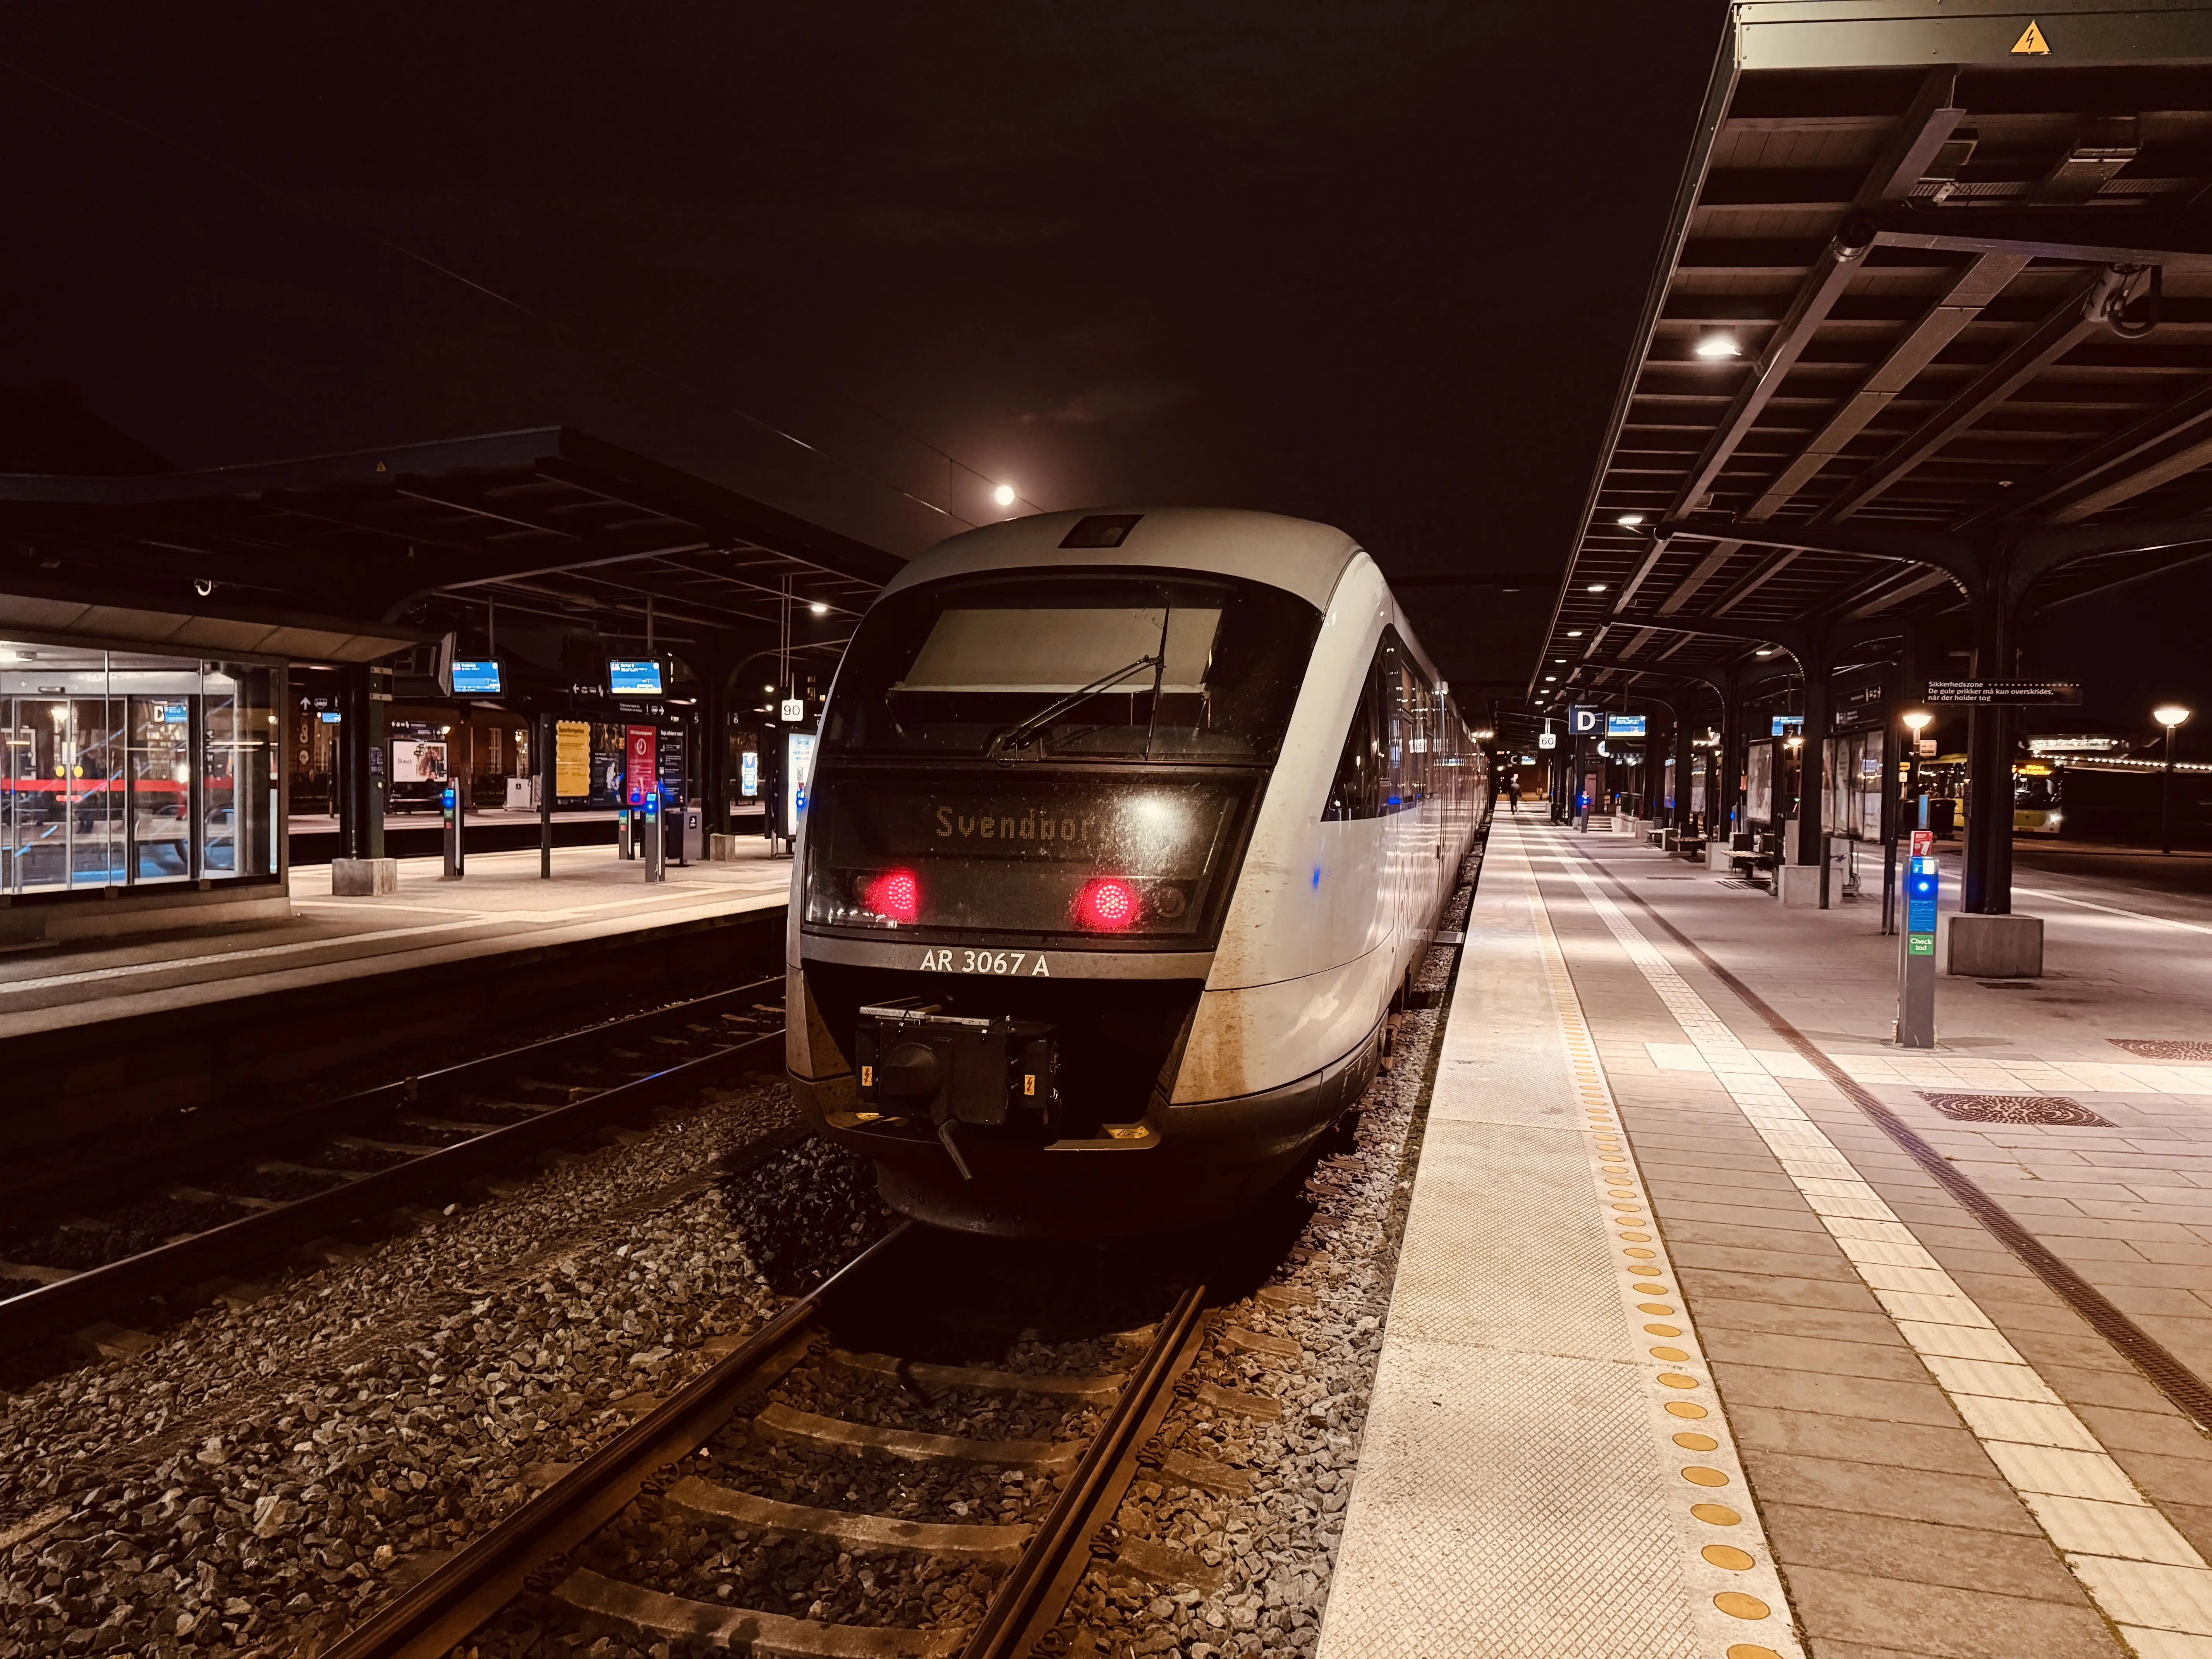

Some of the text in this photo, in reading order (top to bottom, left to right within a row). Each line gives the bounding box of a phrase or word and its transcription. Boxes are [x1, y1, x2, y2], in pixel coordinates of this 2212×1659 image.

[784, 705, 800, 716] 90
[1577, 711, 1595, 731] D
[1510, 755, 1518, 764] C
[936, 806, 1108, 842] Svendbor
[919, 949, 1050, 977] AR 3067 A
